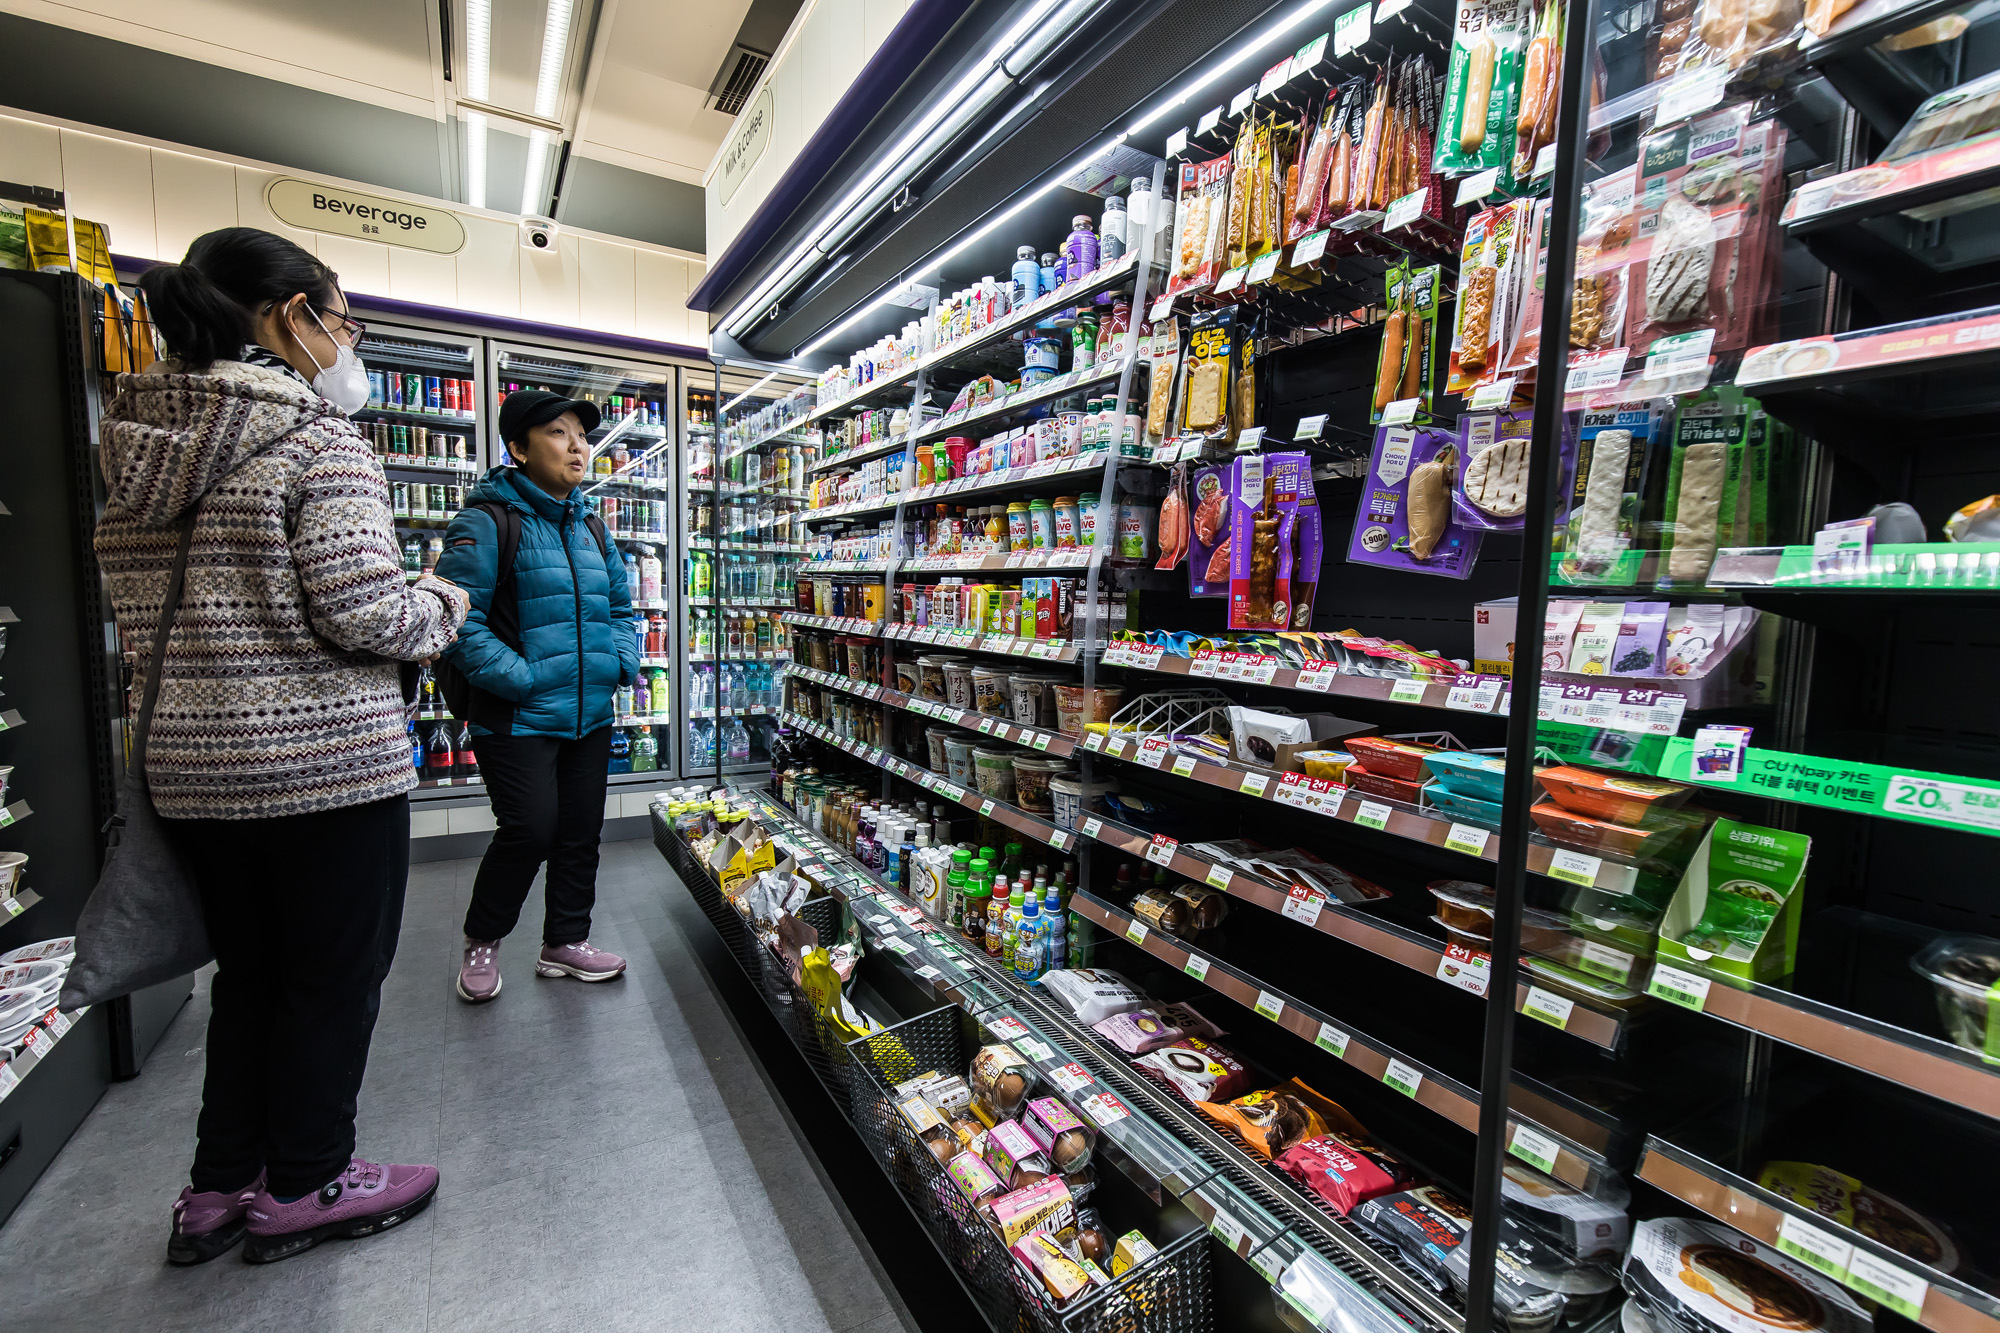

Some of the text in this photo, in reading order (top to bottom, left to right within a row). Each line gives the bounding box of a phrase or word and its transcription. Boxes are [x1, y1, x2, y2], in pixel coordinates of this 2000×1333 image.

[1693, 126, 1738, 150] 닭가슴살
[725, 109, 763, 180] Milk & Coffee
[1198, 160, 1228, 184] BIG
[313, 193, 427, 230] Beverage
[361, 223, 379, 234] 음료
[1641, 215, 1658, 233] NO.1
[1584, 414, 1616, 426] 닭가슴살
[1616, 412, 1649, 425] 오리지널
[1682, 419, 1712, 429] 고단백
[1681, 429, 1725, 440] 닭가슴살
[1384, 452, 1407, 461] CHOICE
[1373, 491, 1400, 502] 닭가슴살
[1370, 500, 1398, 515] 득템
[1197, 651, 1209, 660] 2+1
[1223, 652, 1236, 662] 2+1
[1249, 655, 1262, 665] 2+1
[1305, 661, 1321, 670] 2+1
[1480, 662, 1511, 674] 젤리블리
[1457, 674, 1478, 685] 2+1
[1566, 685, 1591, 697] 2+1
[1626, 689, 1655, 702] 2+1
[1145, 740, 1157, 750] 2+1
[1283, 772, 1298, 783] 2+1
[1764, 759, 1872, 786] CU Npay 카드
[1312, 779, 1328, 791] 2+1
[1751, 773, 1876, 805] 더블 혜택 이벤트
[1895, 785, 1952, 812] 20%
[1155, 835, 1166, 845] 2+1
[1729, 829, 1775, 848] 상큼키위
[1292, 885, 1308, 897] 2+1
[1450, 945, 1470, 960] 2+1
[1069, 1063, 1082, 1076] 2+1
[1102, 1095, 1114, 1108] 2+1
[1302, 1139, 1358, 1172] 고추잡채
